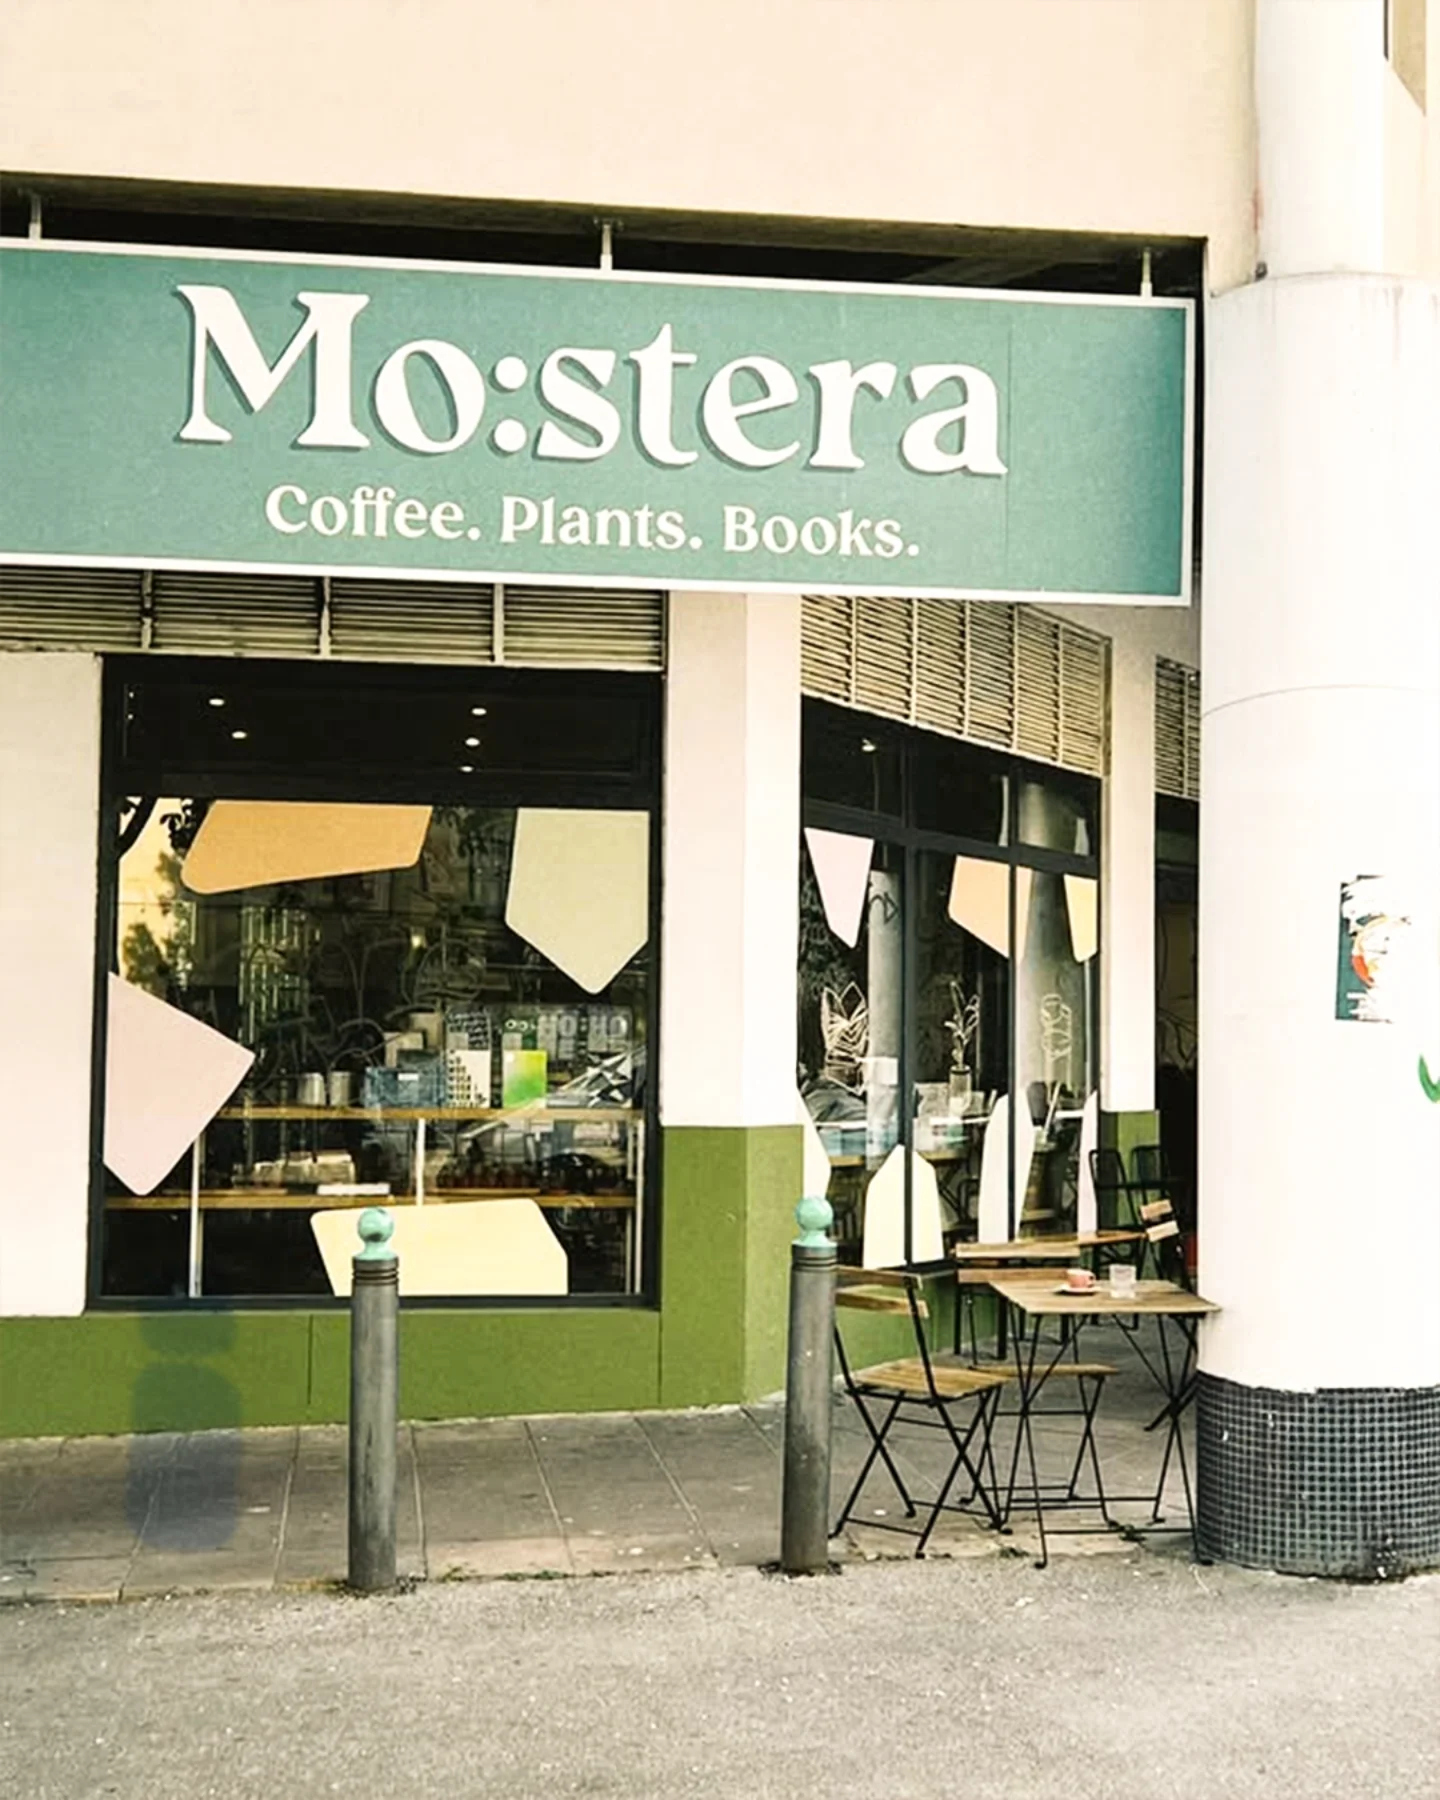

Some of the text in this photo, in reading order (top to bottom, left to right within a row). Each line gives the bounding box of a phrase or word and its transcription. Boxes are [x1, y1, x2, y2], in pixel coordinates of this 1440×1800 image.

[176, 284, 1008, 476] Mo:stera
[265, 484, 920, 558] Coffee. Plants. Books.
